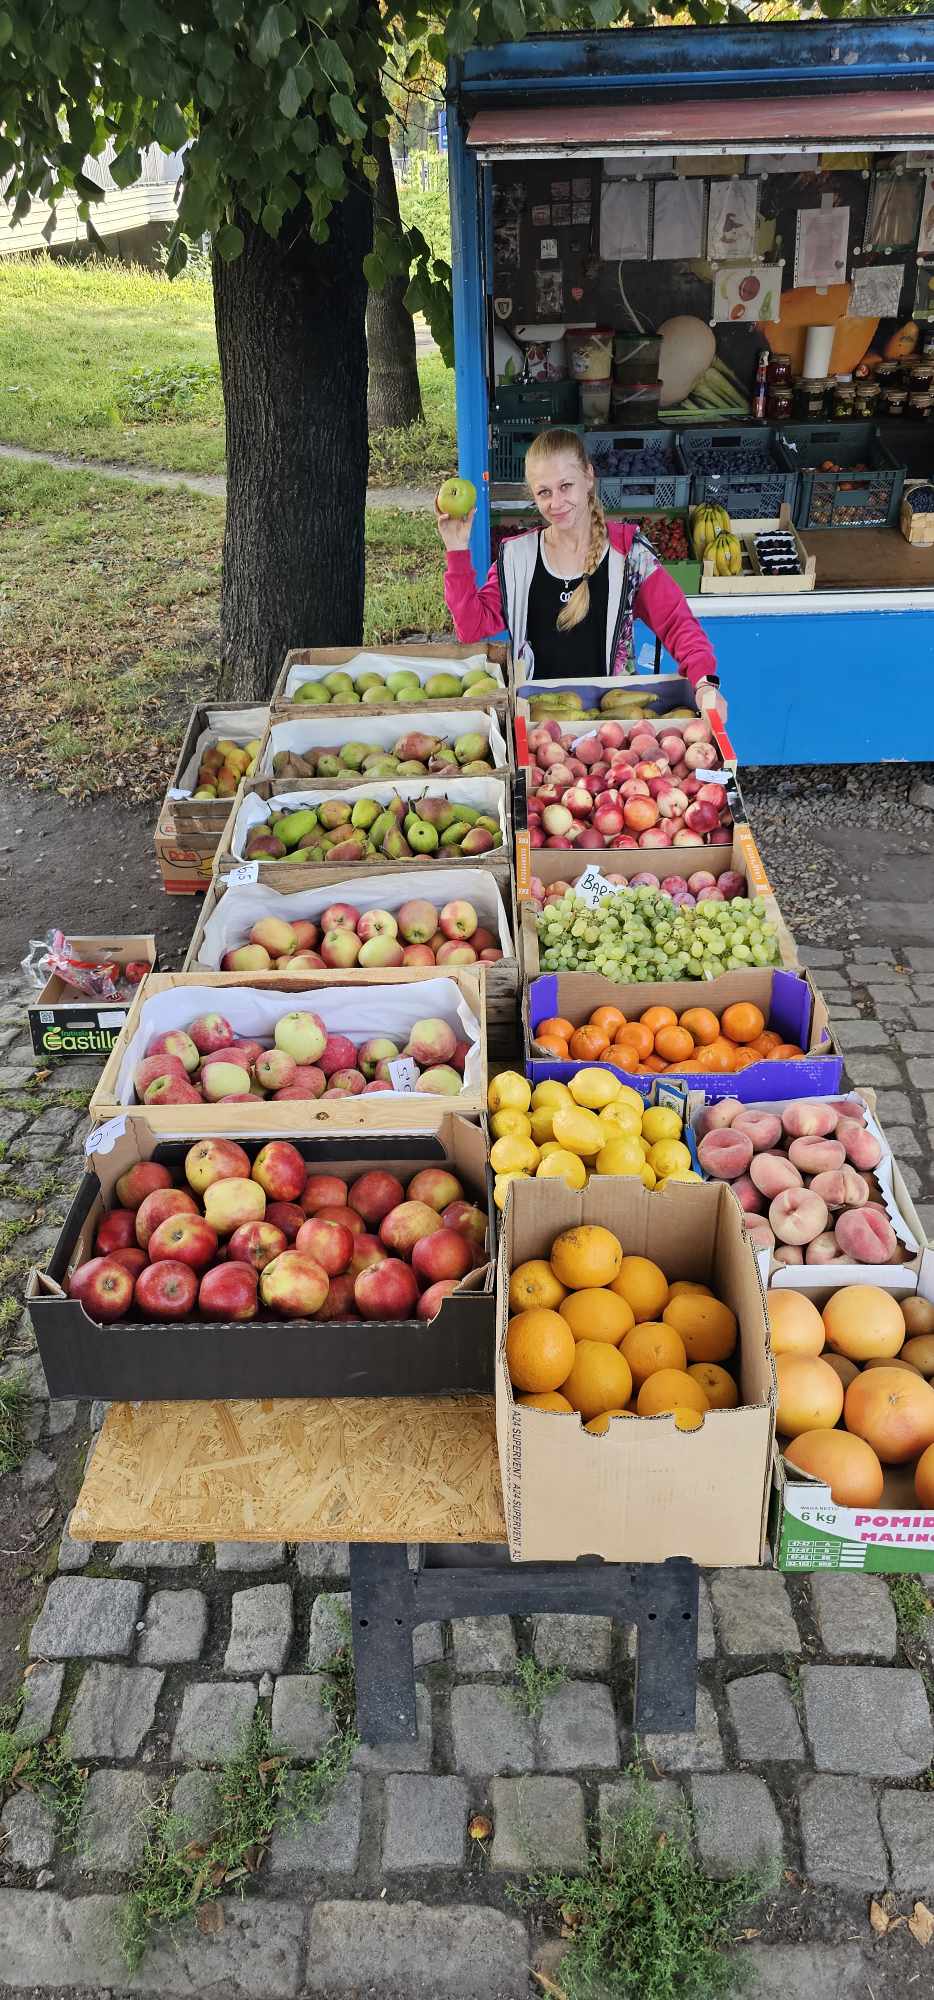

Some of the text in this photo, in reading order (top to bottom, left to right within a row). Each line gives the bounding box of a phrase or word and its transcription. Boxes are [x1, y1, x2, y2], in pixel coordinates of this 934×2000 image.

[512, 1427, 522, 1480] SUPERVENT
[512, 1499, 522, 1547] SUPERVENT
[801, 1512, 837, 1525] 6 kg
[860, 1532, 934, 1543] MALIN
